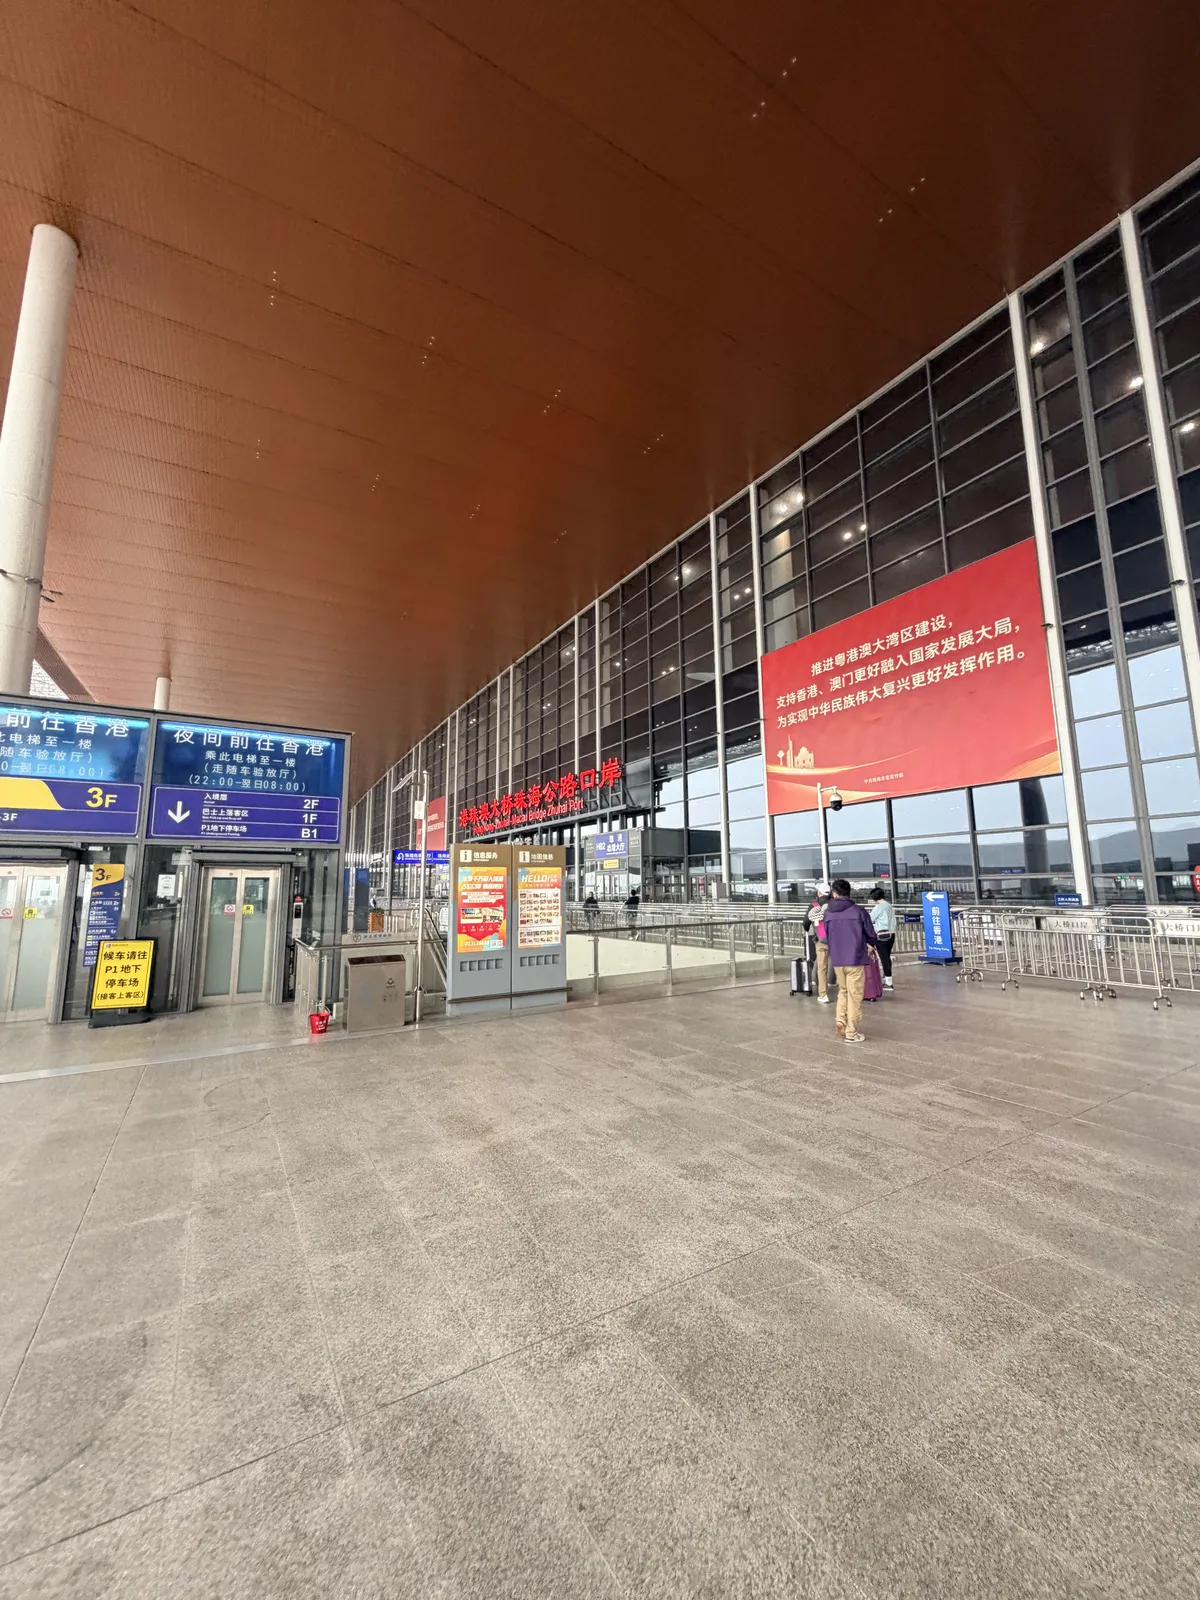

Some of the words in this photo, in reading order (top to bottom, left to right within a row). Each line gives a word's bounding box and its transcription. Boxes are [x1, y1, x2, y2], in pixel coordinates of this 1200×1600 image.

[811, 613, 954, 677] 推进粤港澳大湾区建设，
[776, 616, 1021, 710] 支持香港、澳门更好融入国家发展大局，
[777, 644, 1025, 730] 为实现中华民族伟大复兴更好发挥作用。
[173, 727, 324, 757] 夜间前往香港
[205, 750, 296, 768] 乘此电梯至一楼
[86, 787, 117, 808] 3F
[460, 757, 623, 828] 港珠澳大桥珠海公路口岸
[303, 799, 319, 809] 2F
[529, 808, 547, 822] Bridge
[548, 803, 568, 817] Zhuhai
[570, 798, 584, 812] Port
[203, 808, 249, 817] 巴士上落客区
[302, 814, 317, 823] 1F
[201, 824, 248, 833] P1地下停车场
[301, 828, 318, 838] B1
[95, 868, 112, 881] 3F
[931, 906, 943, 945] 前往香港
[1054, 919, 1089, 929] 大桥口岸
[1165, 922, 1200, 933] 大桥口
[103, 950, 148, 961] 候车请往
[105, 977, 140, 988] 停车场
